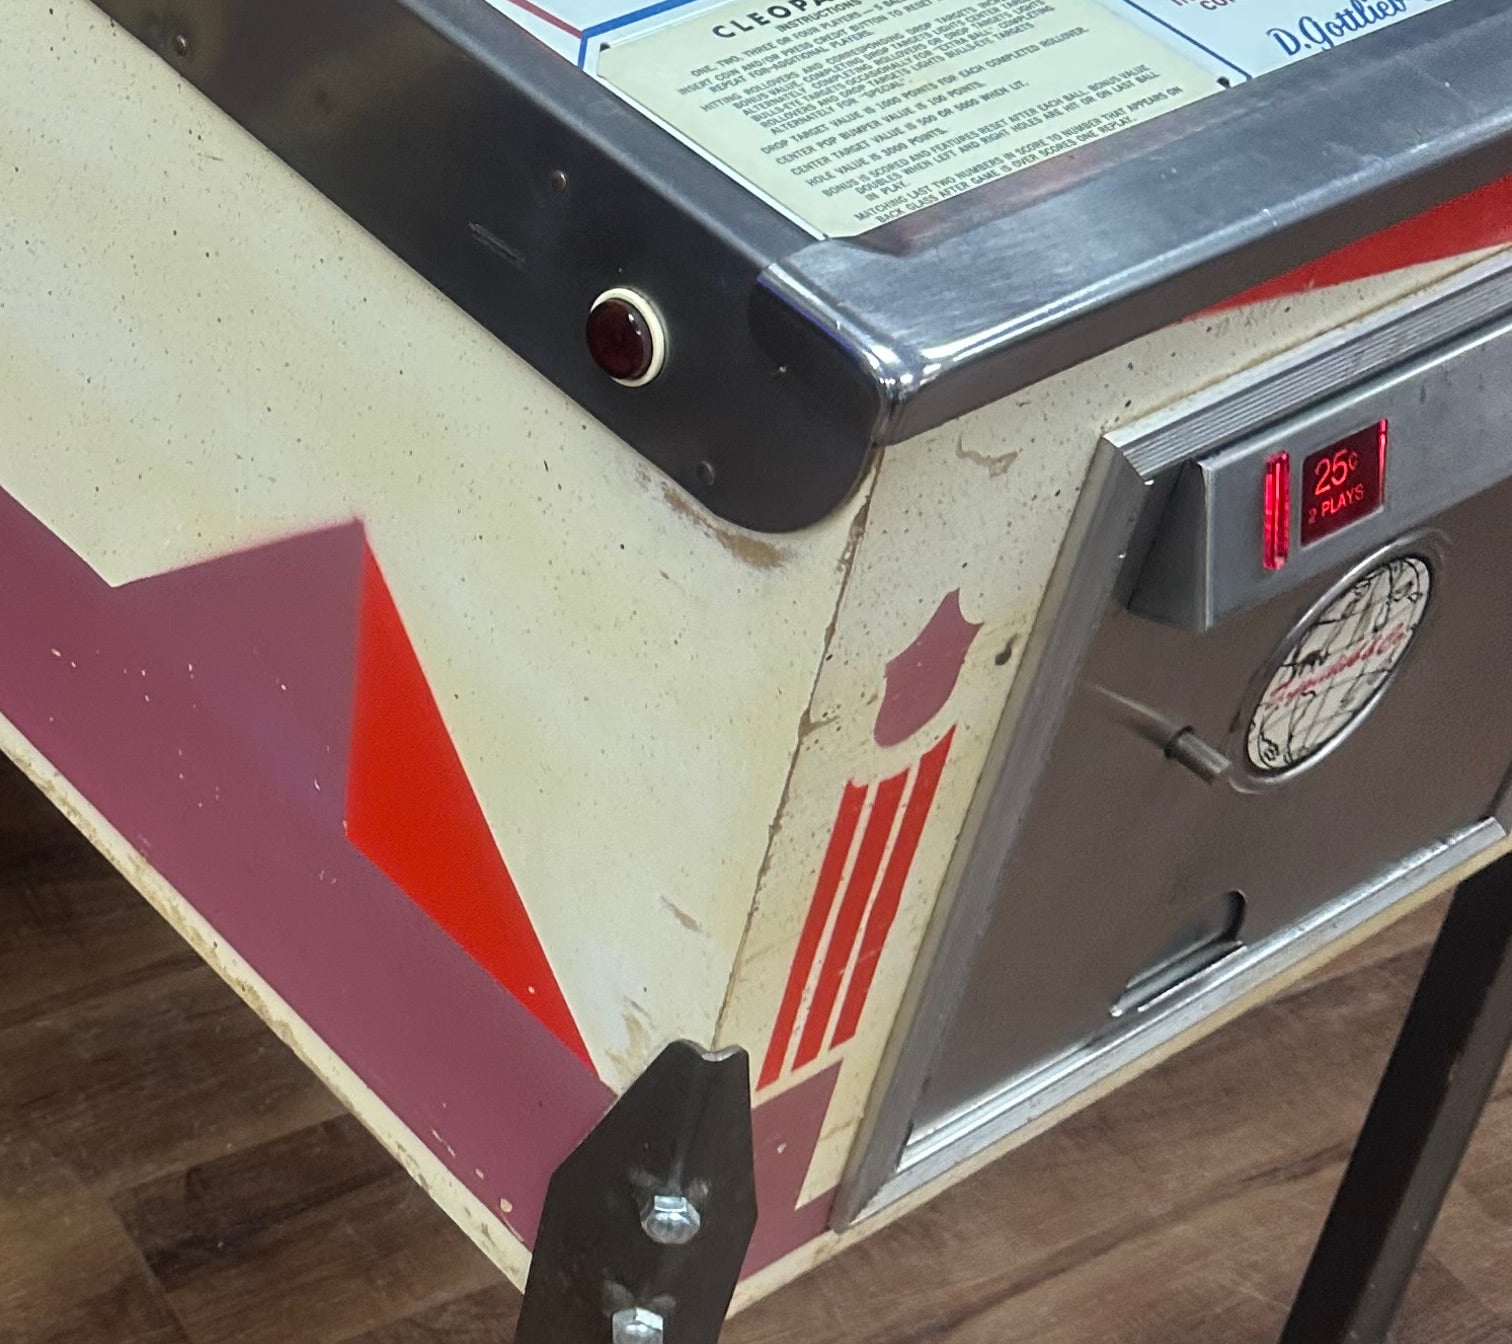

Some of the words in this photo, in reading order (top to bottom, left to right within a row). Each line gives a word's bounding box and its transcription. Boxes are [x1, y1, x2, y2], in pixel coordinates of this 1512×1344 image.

[675, 77, 715, 95] INSERT
[712, 68, 742, 82] COIN
[739, 53, 783, 72] AND/OR
[780, 41, 815, 57] PRESS
[811, 29, 850, 45] CREDIT
[847, 14, 890, 32] BUTTON
[887, 9, 905, 18] TO
[698, 92, 743, 112] HITTING
[741, 70, 802, 96] ROLLOVERS
[799, 62, 826, 74] AND
[823, 32, 906, 65] CORRESPONDING
[730, 91, 770, 109] BONUS
[800, 56, 865, 83] COMPLETING
[889, 31, 934, 50] TARGETS
[741, 42, 778, 58] THREE
[774, 36, 794, 45] OR
[791, 26, 822, 40] FOUR
[801, 82, 847, 102] TARGETS
[843, 57, 915, 86] OCCASIONALLY
[911, 49, 935, 61] FOR
[809, 63, 874, 89] COMPLETING
[872, 43, 928, 66] ROLLOVERS
[925, 37, 945, 46] OR
[706, 75, 748, 93] REPEAT
[758, 102, 818, 128] ROLLOVERS
[814, 94, 841, 107] AND
[837, 83, 870, 98] DROP
[866, 67, 913, 87] TARGETS
[759, 138, 792, 154] DROP
[789, 124, 831, 143] TARGET
[828, 111, 865, 128] VALUE
[861, 106, 878, 115] IS
[875, 96, 904, 110] 1000
[900, 82, 940, 100] POINTS
[937, 74, 961, 86] FOR
[957, 64, 988, 78] EACH
[983, 44, 1042, 68] COMPLETED
[767, 105, 837, 135] ALTERNATELY
[834, 97, 859, 109] FOR
[773, 144, 818, 165] CENTER
[814, 136, 840, 149] POP
[837, 119, 883, 140] BUMPER
[880, 106, 916, 123] VALUE
[912, 101, 929, 110] IS
[925, 94, 949, 105] 100
[788, 155, 833, 175] CENTER
[829, 139, 873, 159] TARGET
[869, 126, 906, 144] VALUE
[902, 121, 919, 131] IS
[915, 114, 939, 126] 500
[935, 107, 956, 118] OR
[952, 97, 982, 111] 5000
[977, 86, 1011, 101] WHEN
[804, 170, 836, 186] HOLE
[832, 157, 870, 175] VALUE
[867, 152, 883, 161] IS
[879, 141, 909, 156] 3000
[819, 177, 861, 197] BONUS
[855, 173, 872, 183] IS
[867, 157, 912, 178] SCORED
[906, 149, 933, 162] AND
[928, 130, 982, 154] FEATURES
[976, 118, 1011, 135] RESET
[1005, 107, 1041, 123] AFTER
[1034, 97, 1065, 111] EACH
[1085, 75, 1123, 91] BONUS
[1117, 63, 1151, 79] VALUE
[852, 195, 909, 221] MATCHING
[905, 185, 934, 199] LAST
[931, 175, 958, 189] TWO
[953, 156, 1006, 180] NUMBERS
[1001, 151, 1018, 161] IN
[1013, 139, 1050, 156] SCORE
[1045, 133, 1064, 143] TO
[1059, 117, 1105, 137] NUMBER
[1099, 107, 1129, 121] THAT
[1122, 91, 1169, 112] APPEARS
[1162, 85, 1184, 96] ON
[853, 171, 904, 194] DOUBLES
[900, 159, 935, 175] WHEN
[931, 149, 959, 163] LEFT
[955, 140, 983, 153] AND
[978, 128, 1014, 144] RIGHT
[1008, 116, 1044, 132] HOLES
[1039, 108, 1065, 120] ARE
[1060, 101, 1082, 112] HIT
[1077, 95, 1098, 105] OR
[1093, 88, 1114, 99] ON
[1109, 79, 1138, 92] LAST
[1132, 70, 1161, 83] BALL
[863, 192, 880, 202] IN
[874, 207, 906, 223] BACK
[903, 193, 940, 211] GLASS
[936, 181, 971, 198] AFTER
[968, 169, 1002, 185] GAME
[998, 164, 1014, 173] IS
[1010, 153, 1041, 168] OVER
[1037, 138, 1078, 157] SCORES
[1074, 129, 1100, 142] ONE
[1321, 483, 1365, 517] PLAYS
